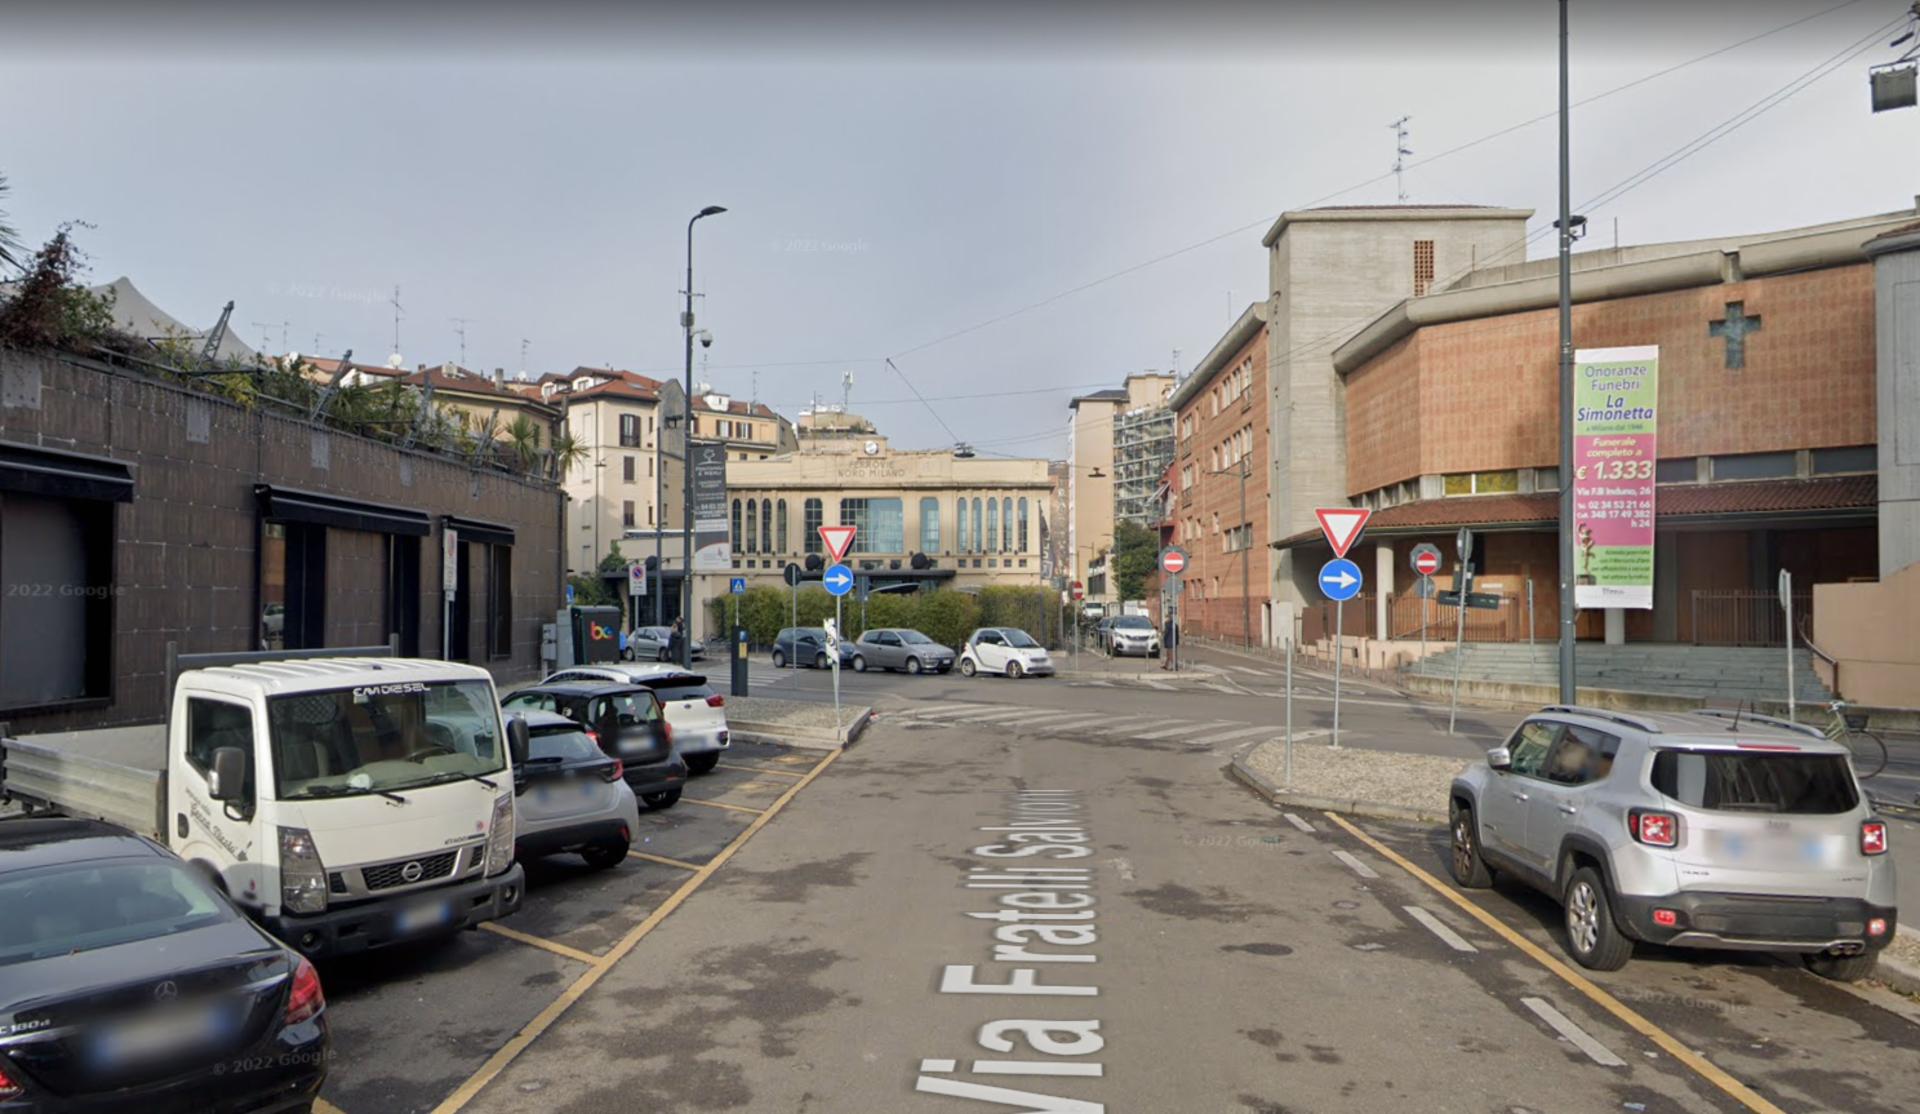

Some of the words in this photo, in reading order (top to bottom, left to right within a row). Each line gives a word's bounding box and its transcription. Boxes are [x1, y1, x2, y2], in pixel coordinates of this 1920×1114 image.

[1584, 365, 1648, 378] Onoranze
[1591, 378, 1640, 391] Funebri
[1606, 394, 1624, 408] La
[1577, 406, 1654, 422] Simonetta
[1592, 436, 1637, 447] Funerale
[1586, 448, 1634, 459] completo
[849, 460, 896, 469] FERROVIE
[1576, 465, 1588, 480] €
[1593, 460, 1653, 480] 1.333
[838, 468, 866, 478] NORD
[868, 468, 905, 478] MILANO
[1576, 487, 1590, 496] Via
